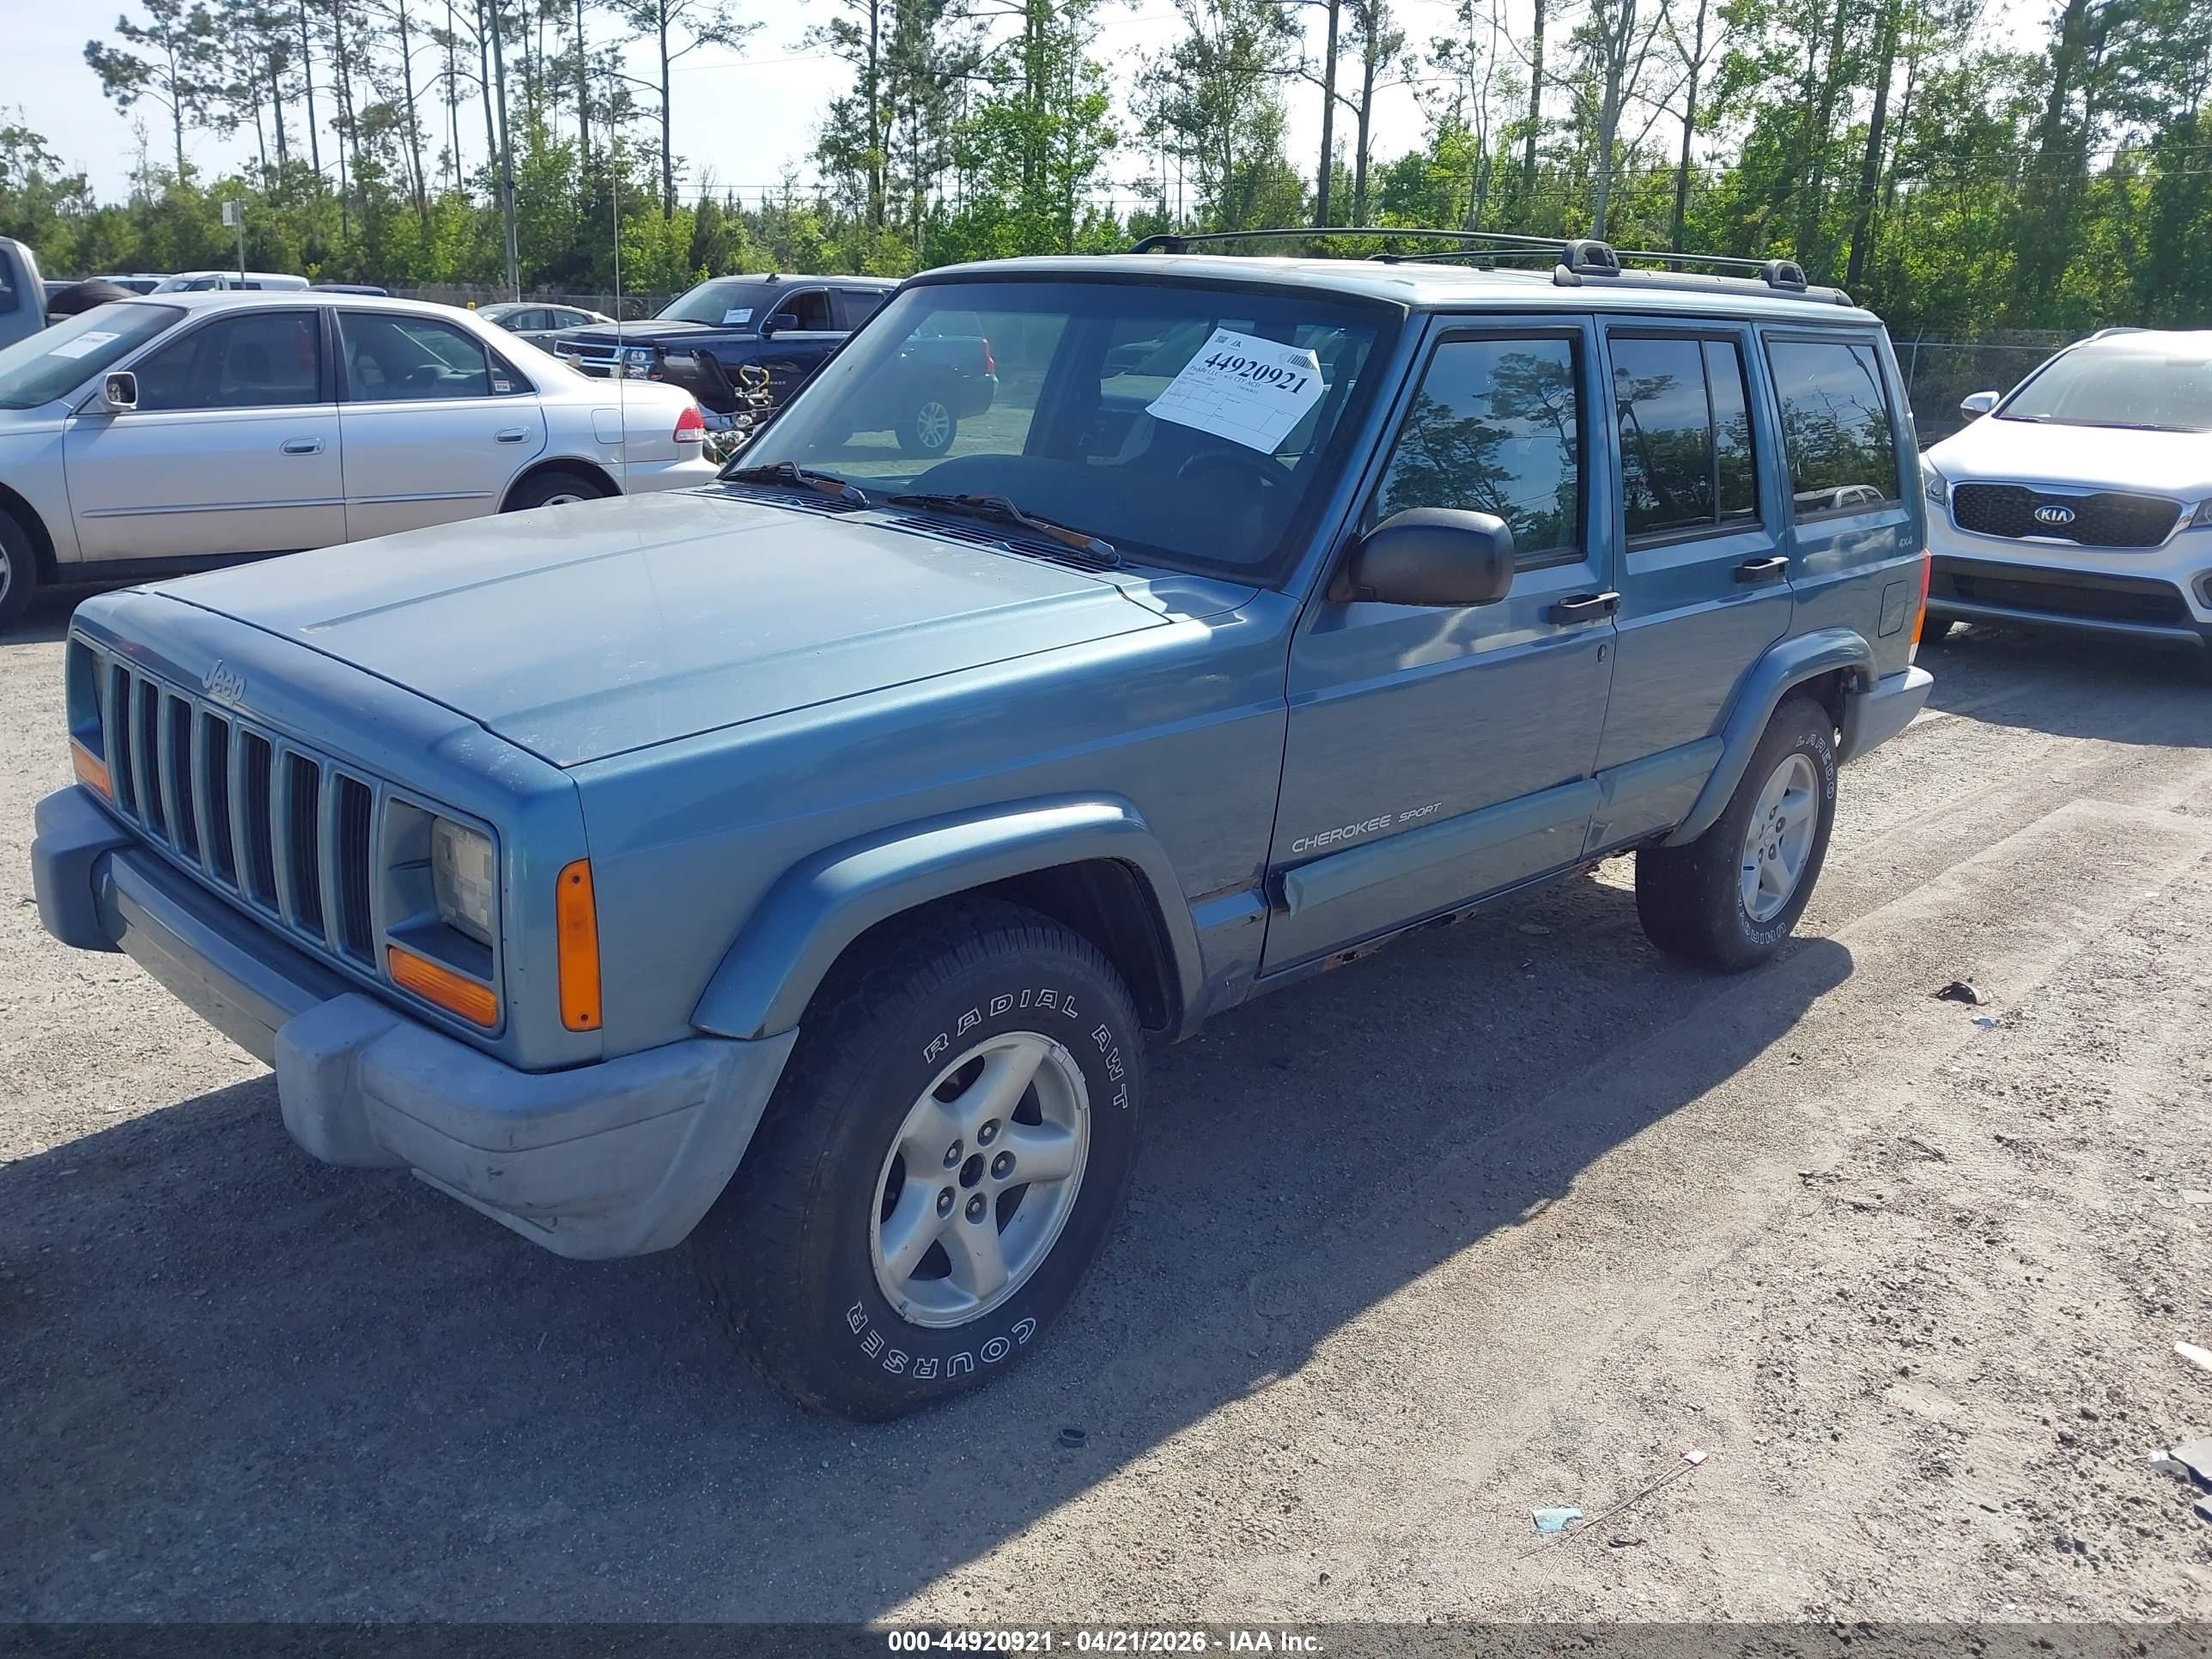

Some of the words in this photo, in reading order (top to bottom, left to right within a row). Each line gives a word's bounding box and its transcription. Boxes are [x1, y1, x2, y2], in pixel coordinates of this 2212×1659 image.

[1204, 351, 1310, 395] 44920921
[2040, 508, 2068, 522] KIA
[201, 658, 247, 707] Jeep
[1795, 732, 1835, 800] LAREDO
[1291, 814, 1392, 854] CHEROKEE
[1397, 802, 1443, 823] SPORT
[922, 988, 1079, 1065] RADIAL
[1091, 1023, 1129, 1109] AWT
[845, 1301, 1037, 1380] COURSER
